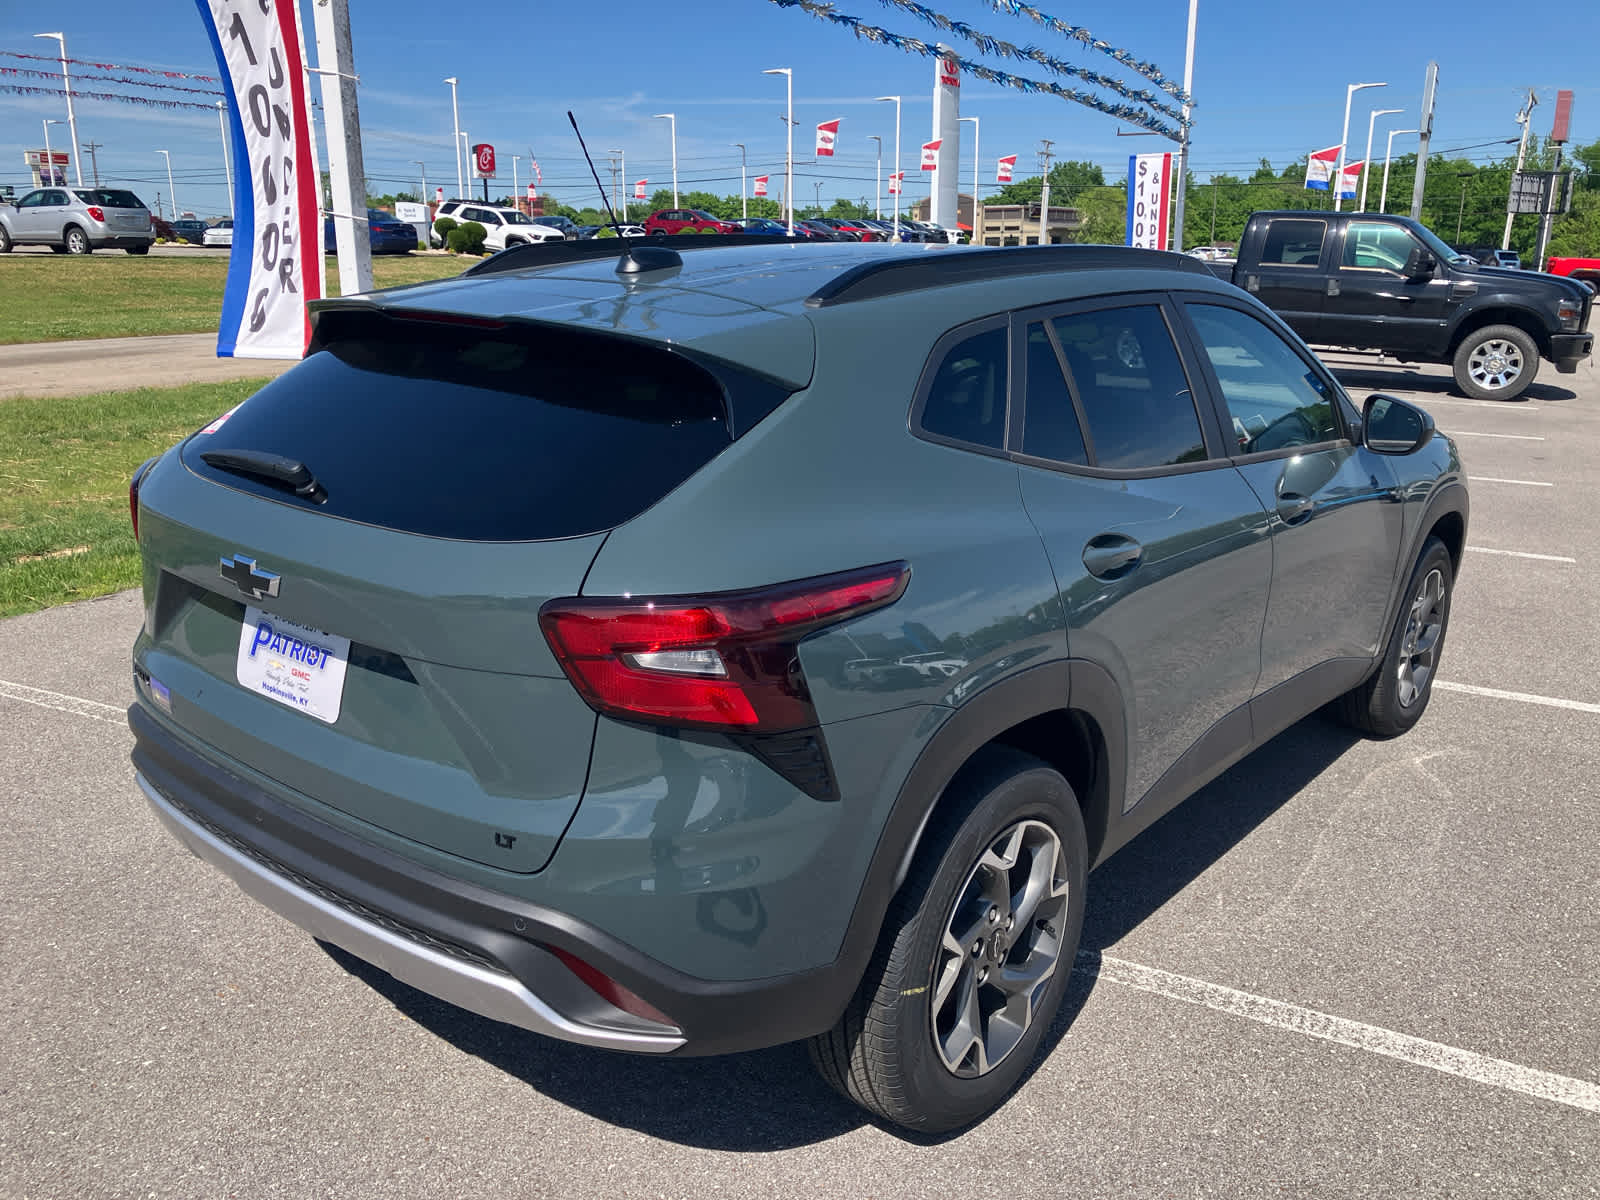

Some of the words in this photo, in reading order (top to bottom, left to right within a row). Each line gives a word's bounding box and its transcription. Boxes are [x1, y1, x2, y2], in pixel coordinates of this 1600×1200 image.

[250, 619, 334, 670] PATRIOT
[291, 667, 311, 682] GMC
[299, 696, 310, 707] KY
[495, 832, 517, 850] LT
